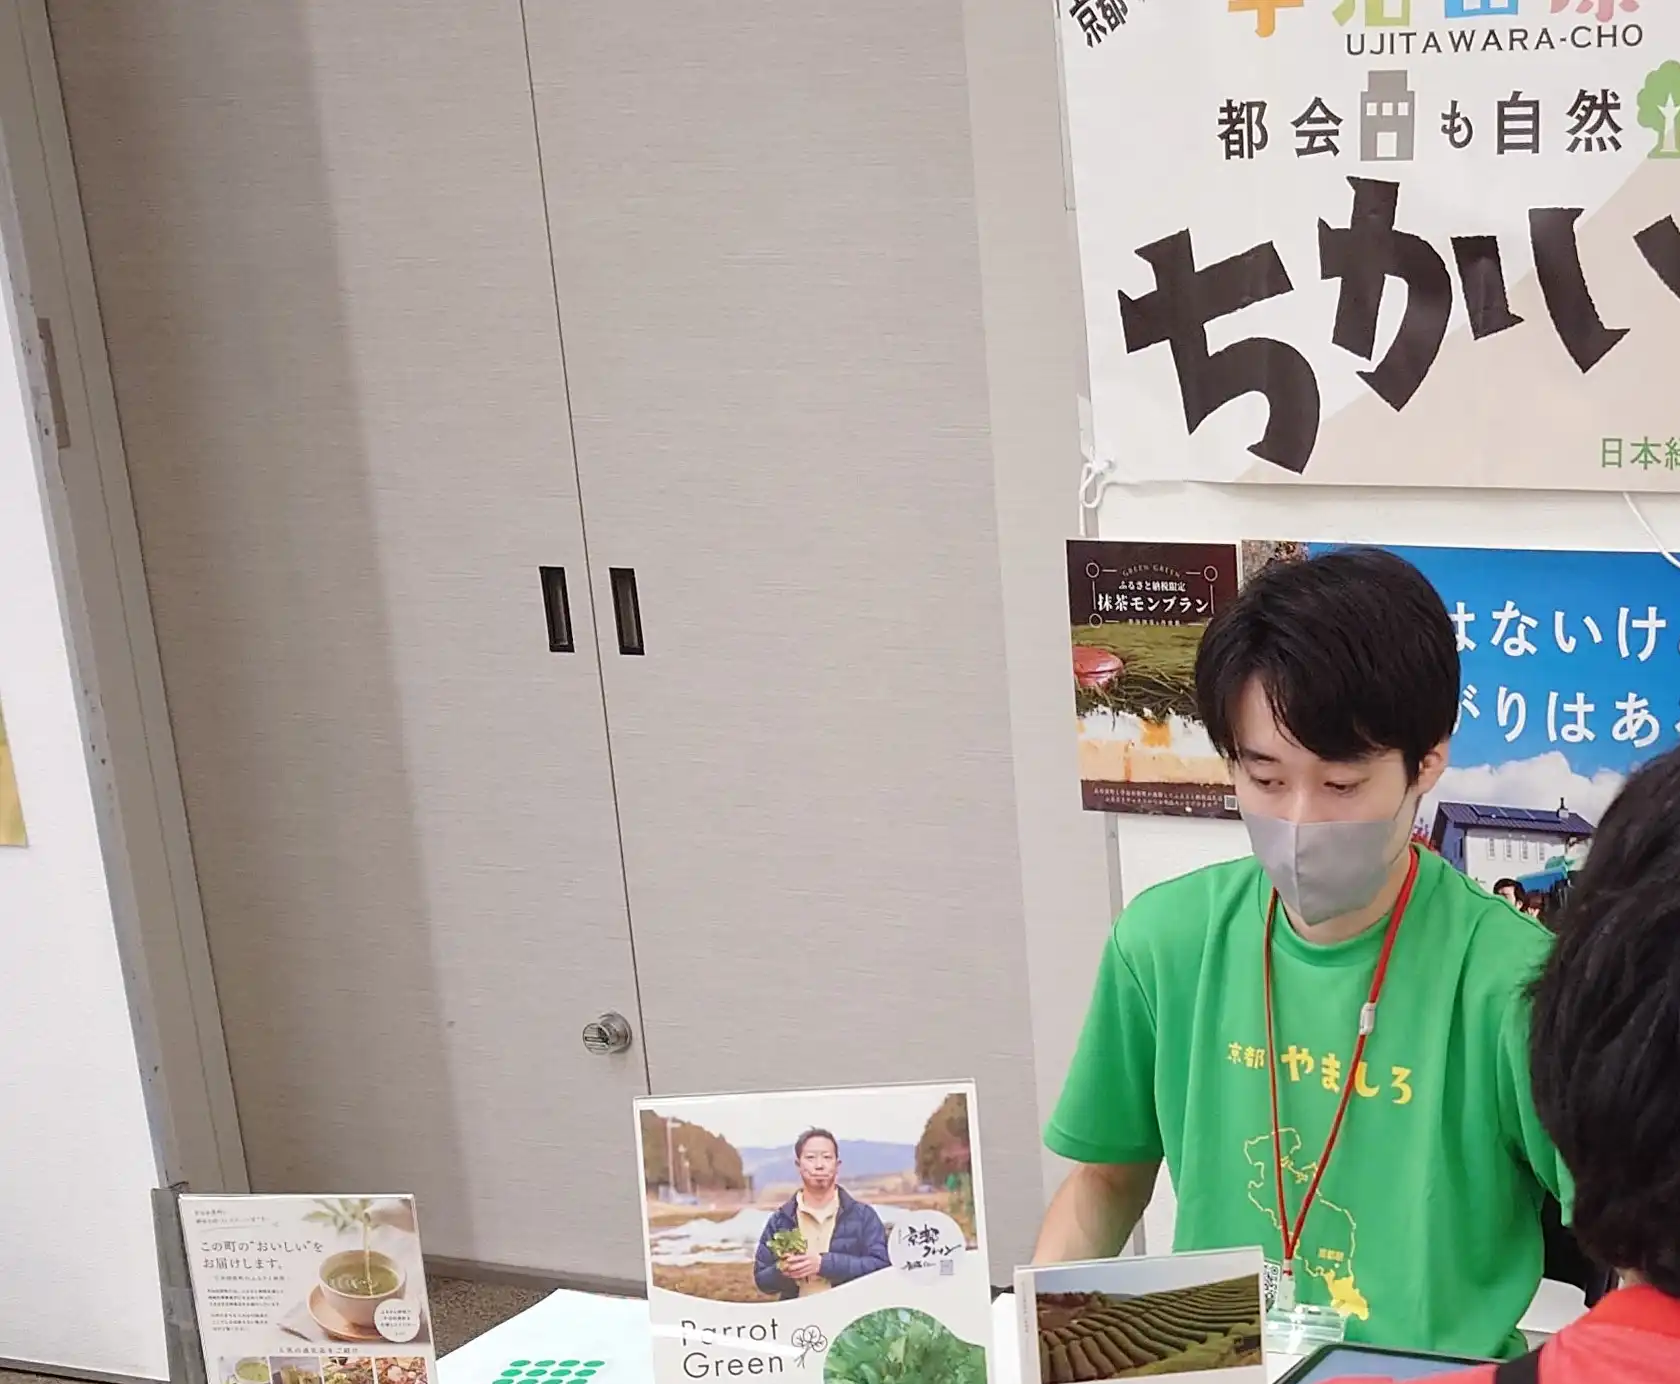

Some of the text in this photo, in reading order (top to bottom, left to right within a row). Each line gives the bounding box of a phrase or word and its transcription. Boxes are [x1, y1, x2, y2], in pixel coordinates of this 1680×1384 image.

[1345, 23, 1645, 56] UJITAWARA-CHO
[1097, 593, 1210, 614] 抹茶モンブラン
[1227, 1042, 1266, 1069] 京都
[683, 1351, 784, 1379] Green
